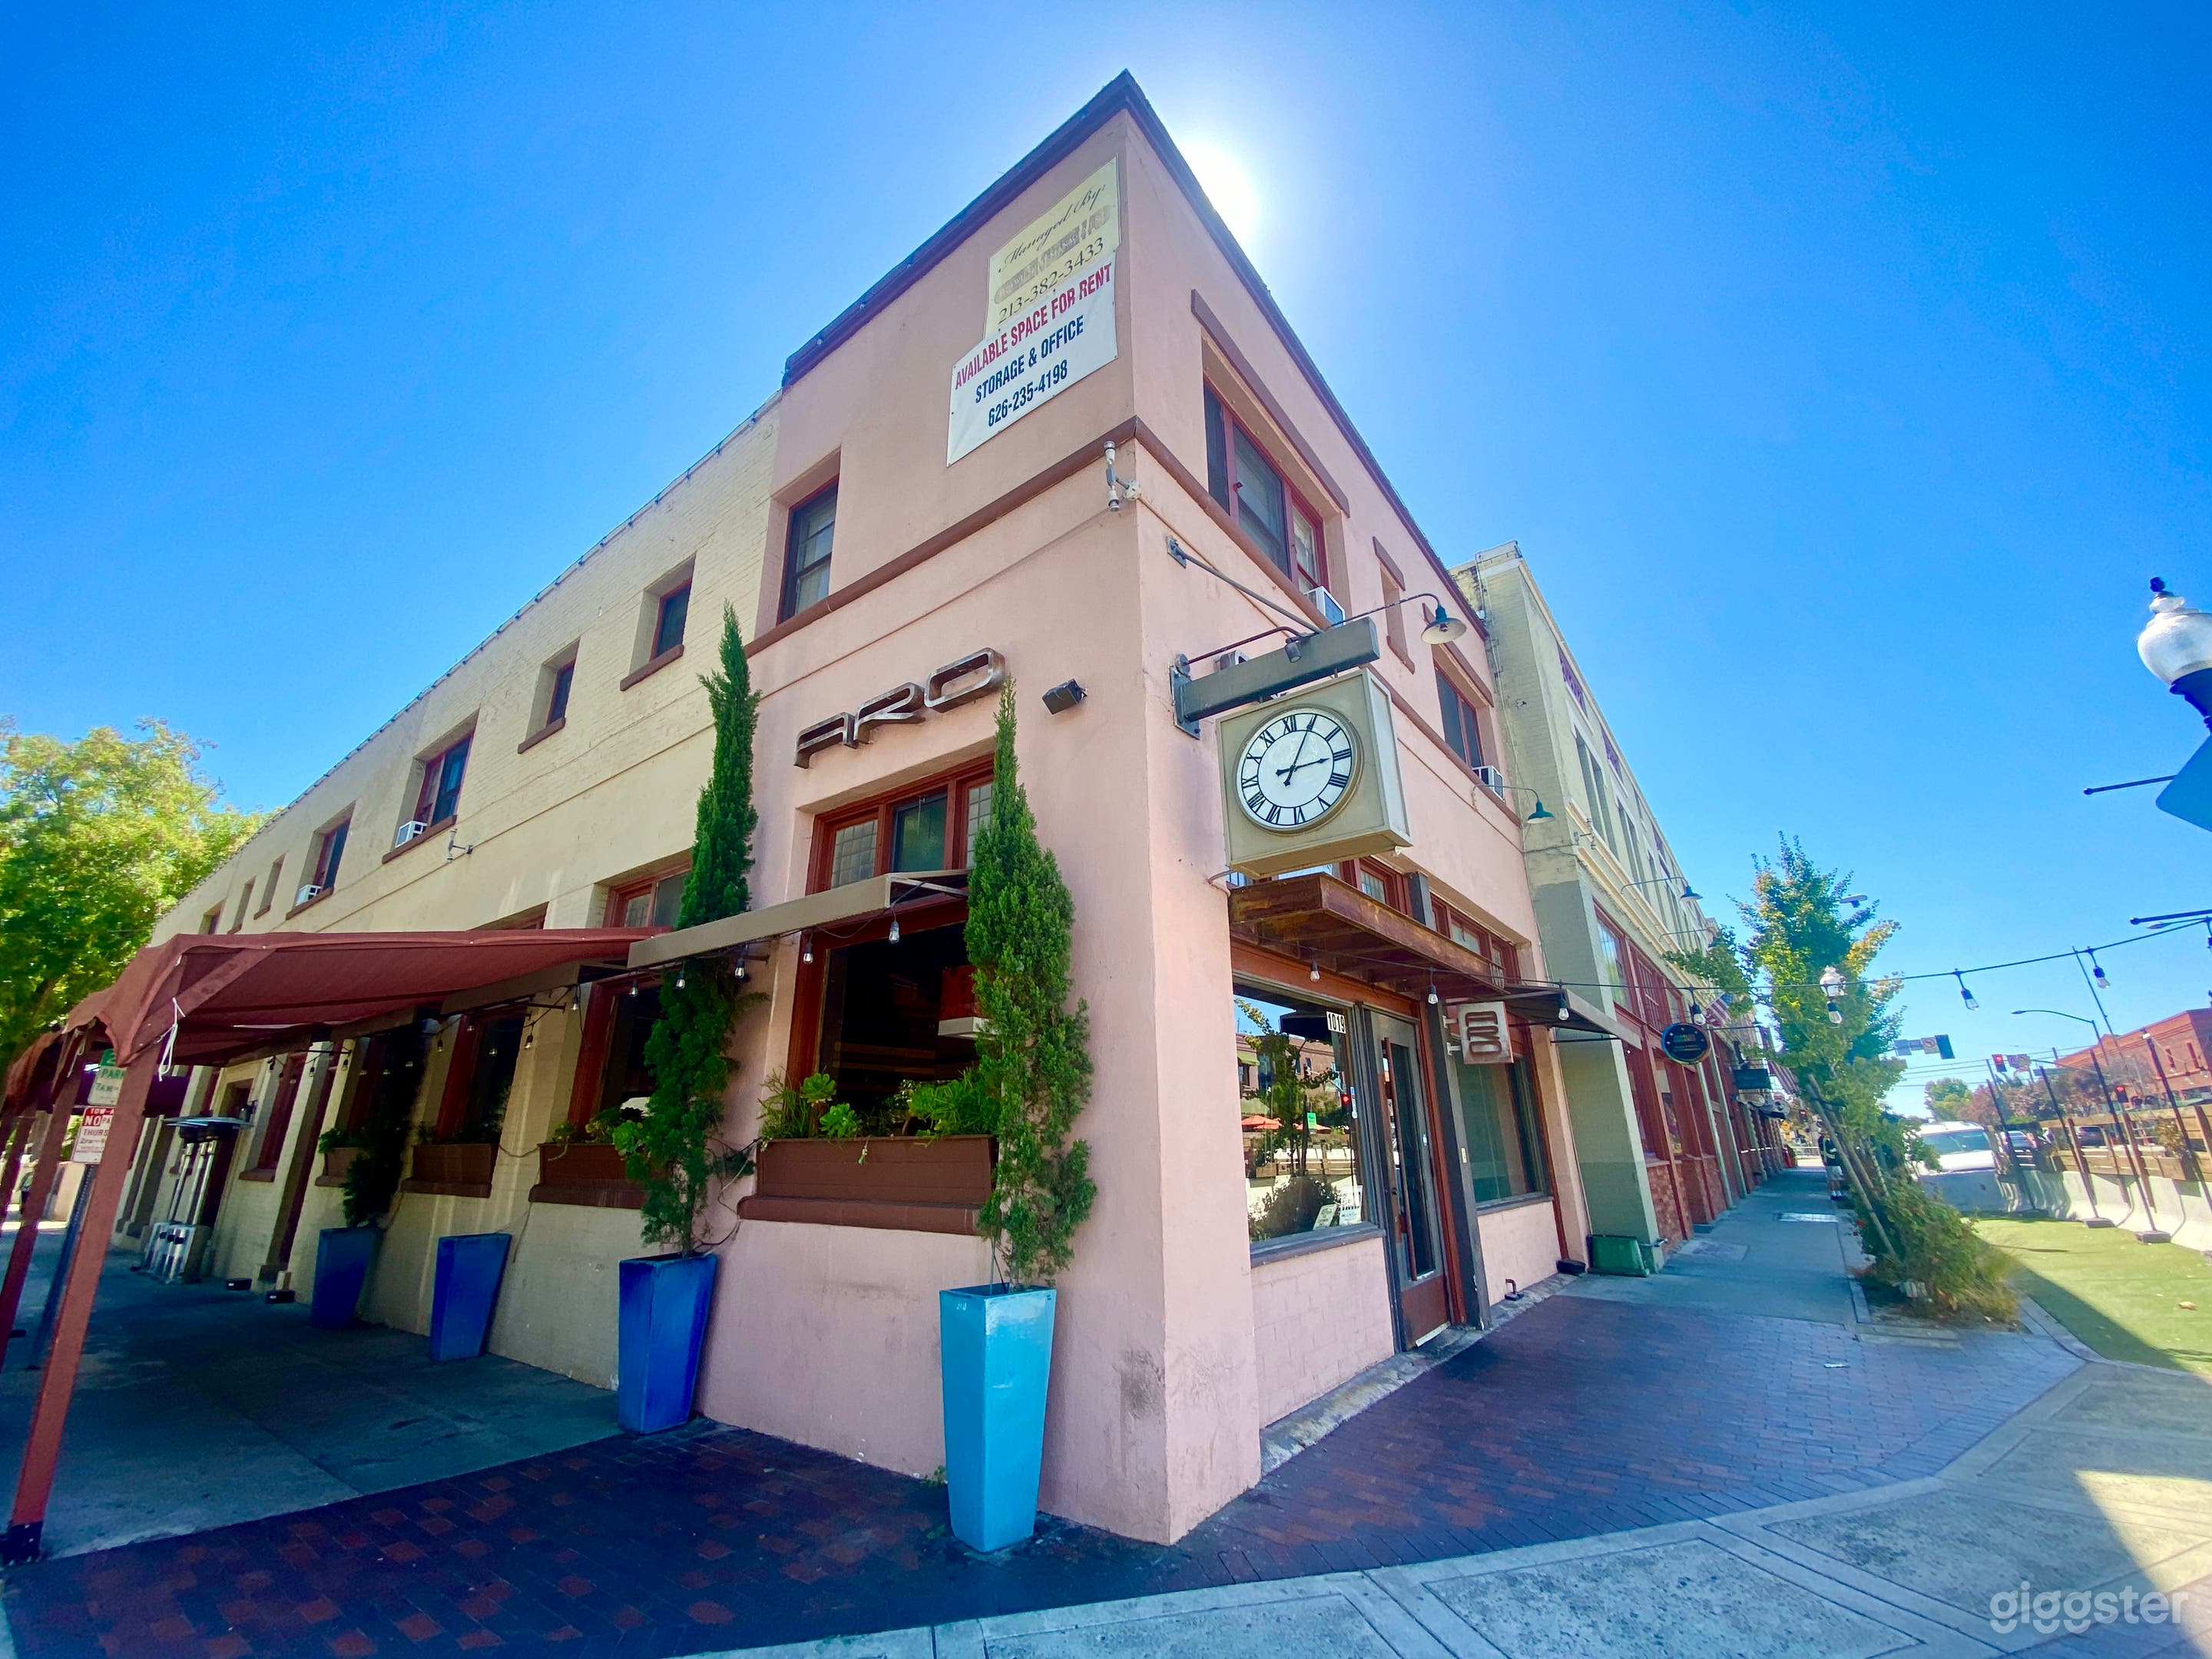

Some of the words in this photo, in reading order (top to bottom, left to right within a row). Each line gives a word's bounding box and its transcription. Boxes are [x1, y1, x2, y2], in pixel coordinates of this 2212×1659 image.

[998, 237, 1104, 325] 213-382-3433
[955, 333, 1008, 389] AVAILABLE
[1011, 305, 1048, 346] SPACE
[1051, 287, 1075, 320] FOR
[1079, 263, 1112, 300] RENT
[975, 354, 1025, 403] STORAGE
[1028, 347, 1037, 367] &
[1041, 315, 1084, 359] OFFICE
[988, 359, 1068, 427] 626-235-4198
[1328, 1013, 1345, 1033] 1019
[84, 1115, 101, 1126] NO
